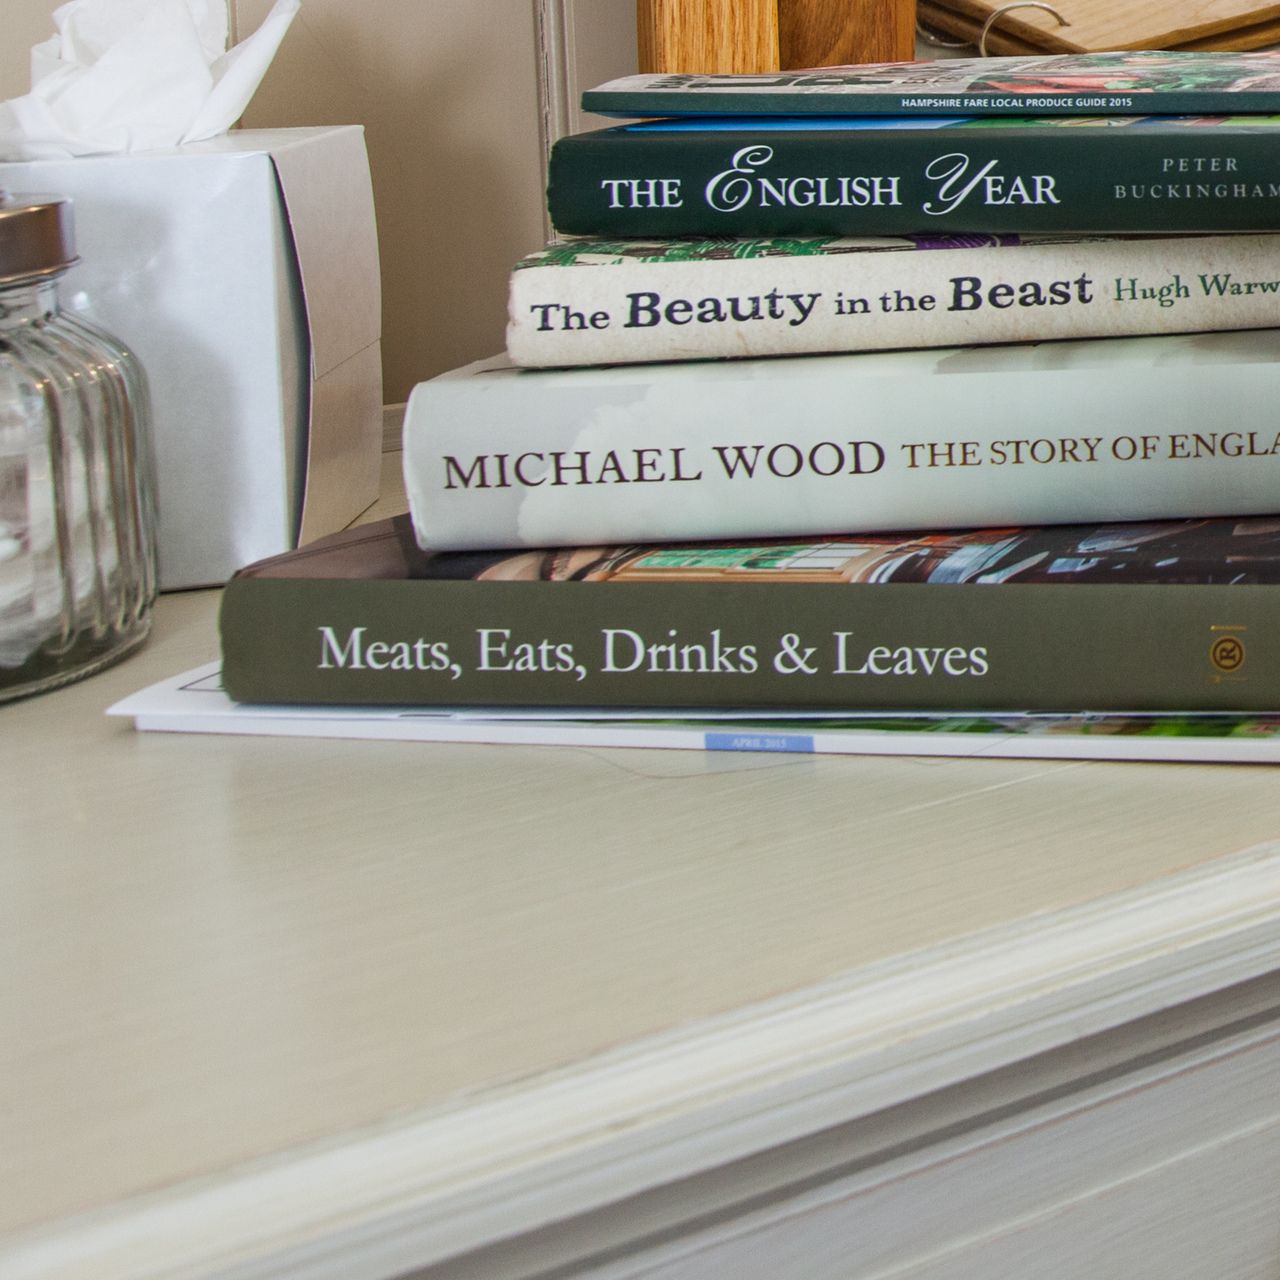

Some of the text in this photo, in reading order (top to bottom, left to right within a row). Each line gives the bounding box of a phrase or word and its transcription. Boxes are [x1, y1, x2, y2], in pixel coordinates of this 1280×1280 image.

[901, 97, 1133, 108] HAMPSHIRE FARE LOCAL PRODUCE GUIDE 2015
[600, 145, 1061, 215] THE ENGLISH YEAR
[1162, 157, 1238, 172] PETER
[530, 302, 611, 332] The
[622, 287, 821, 328] Beauty
[834, 291, 871, 316] in
[879, 288, 938, 313] the
[947, 272, 1094, 312] Beast
[1114, 274, 1191, 308] Hugh
[442, 447, 702, 489] MICHAEL
[713, 440, 886, 480] WOOD
[901, 441, 982, 468] THE
[989, 437, 1103, 466] STORY
[1111, 434, 1160, 461] OF
[317, 626, 989, 681] Meats, Eats, Drinks & Leaves
